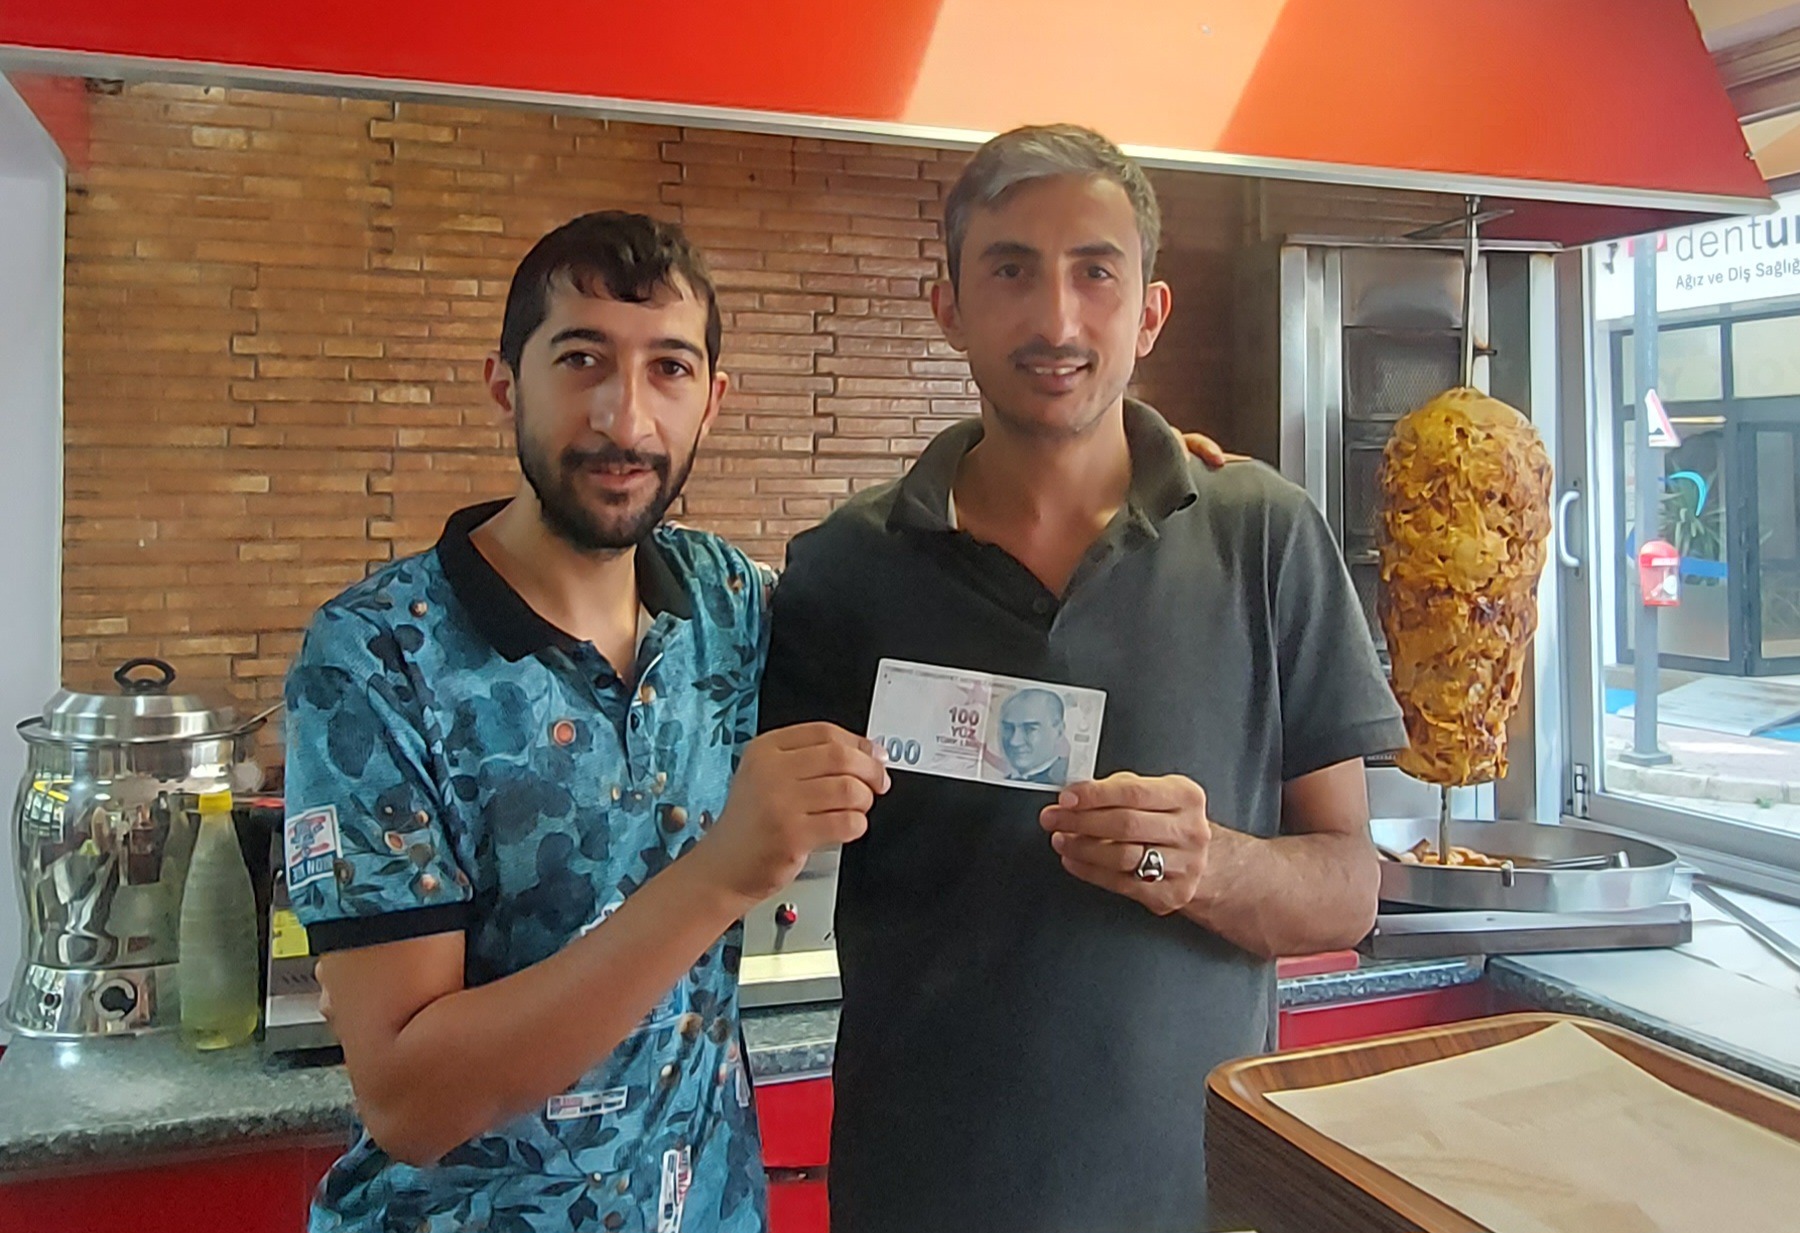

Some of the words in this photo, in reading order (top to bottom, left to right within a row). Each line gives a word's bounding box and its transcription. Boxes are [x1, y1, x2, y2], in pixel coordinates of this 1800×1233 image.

[1676, 274, 1704, 291] Ağız
[1708, 272, 1724, 285] ve
[1728, 266, 1751, 283] Diş
[949, 706, 980, 726] 100
